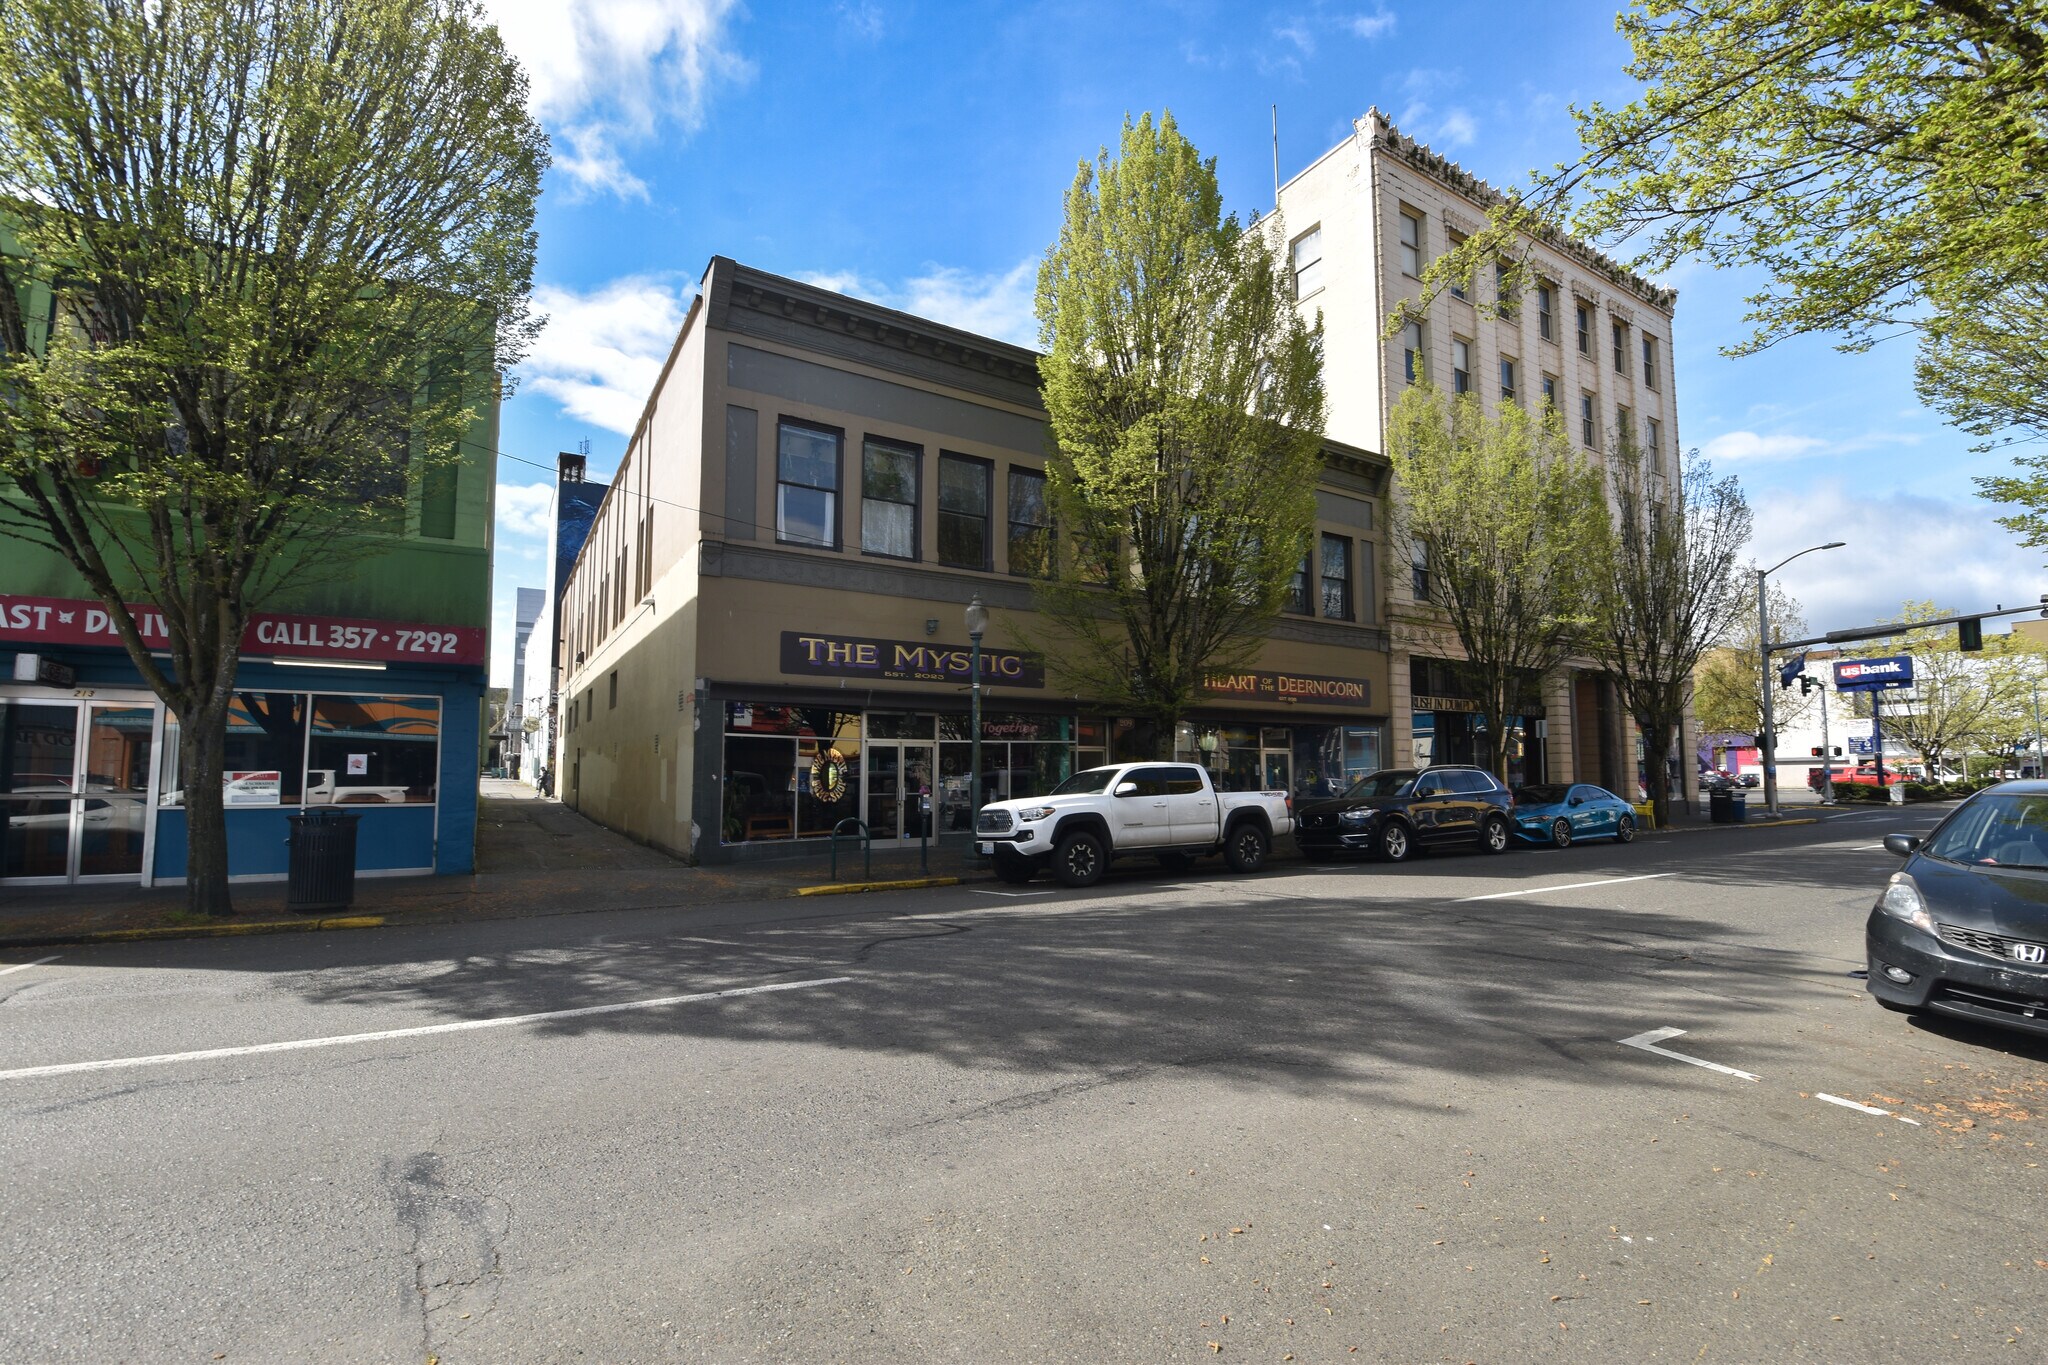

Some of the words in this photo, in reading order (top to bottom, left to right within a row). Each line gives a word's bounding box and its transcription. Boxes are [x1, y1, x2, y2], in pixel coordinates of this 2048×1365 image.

[257, 620, 324, 647] CALL
[799, 637, 878, 665] THE
[894, 644, 1022, 676] MYSTIC
[74, 690, 95, 698] 213
[1204, 674, 1257, 691] HEART
[1278, 676, 1364, 698] DEERNICORN
[982, 721, 1039, 735] Together
